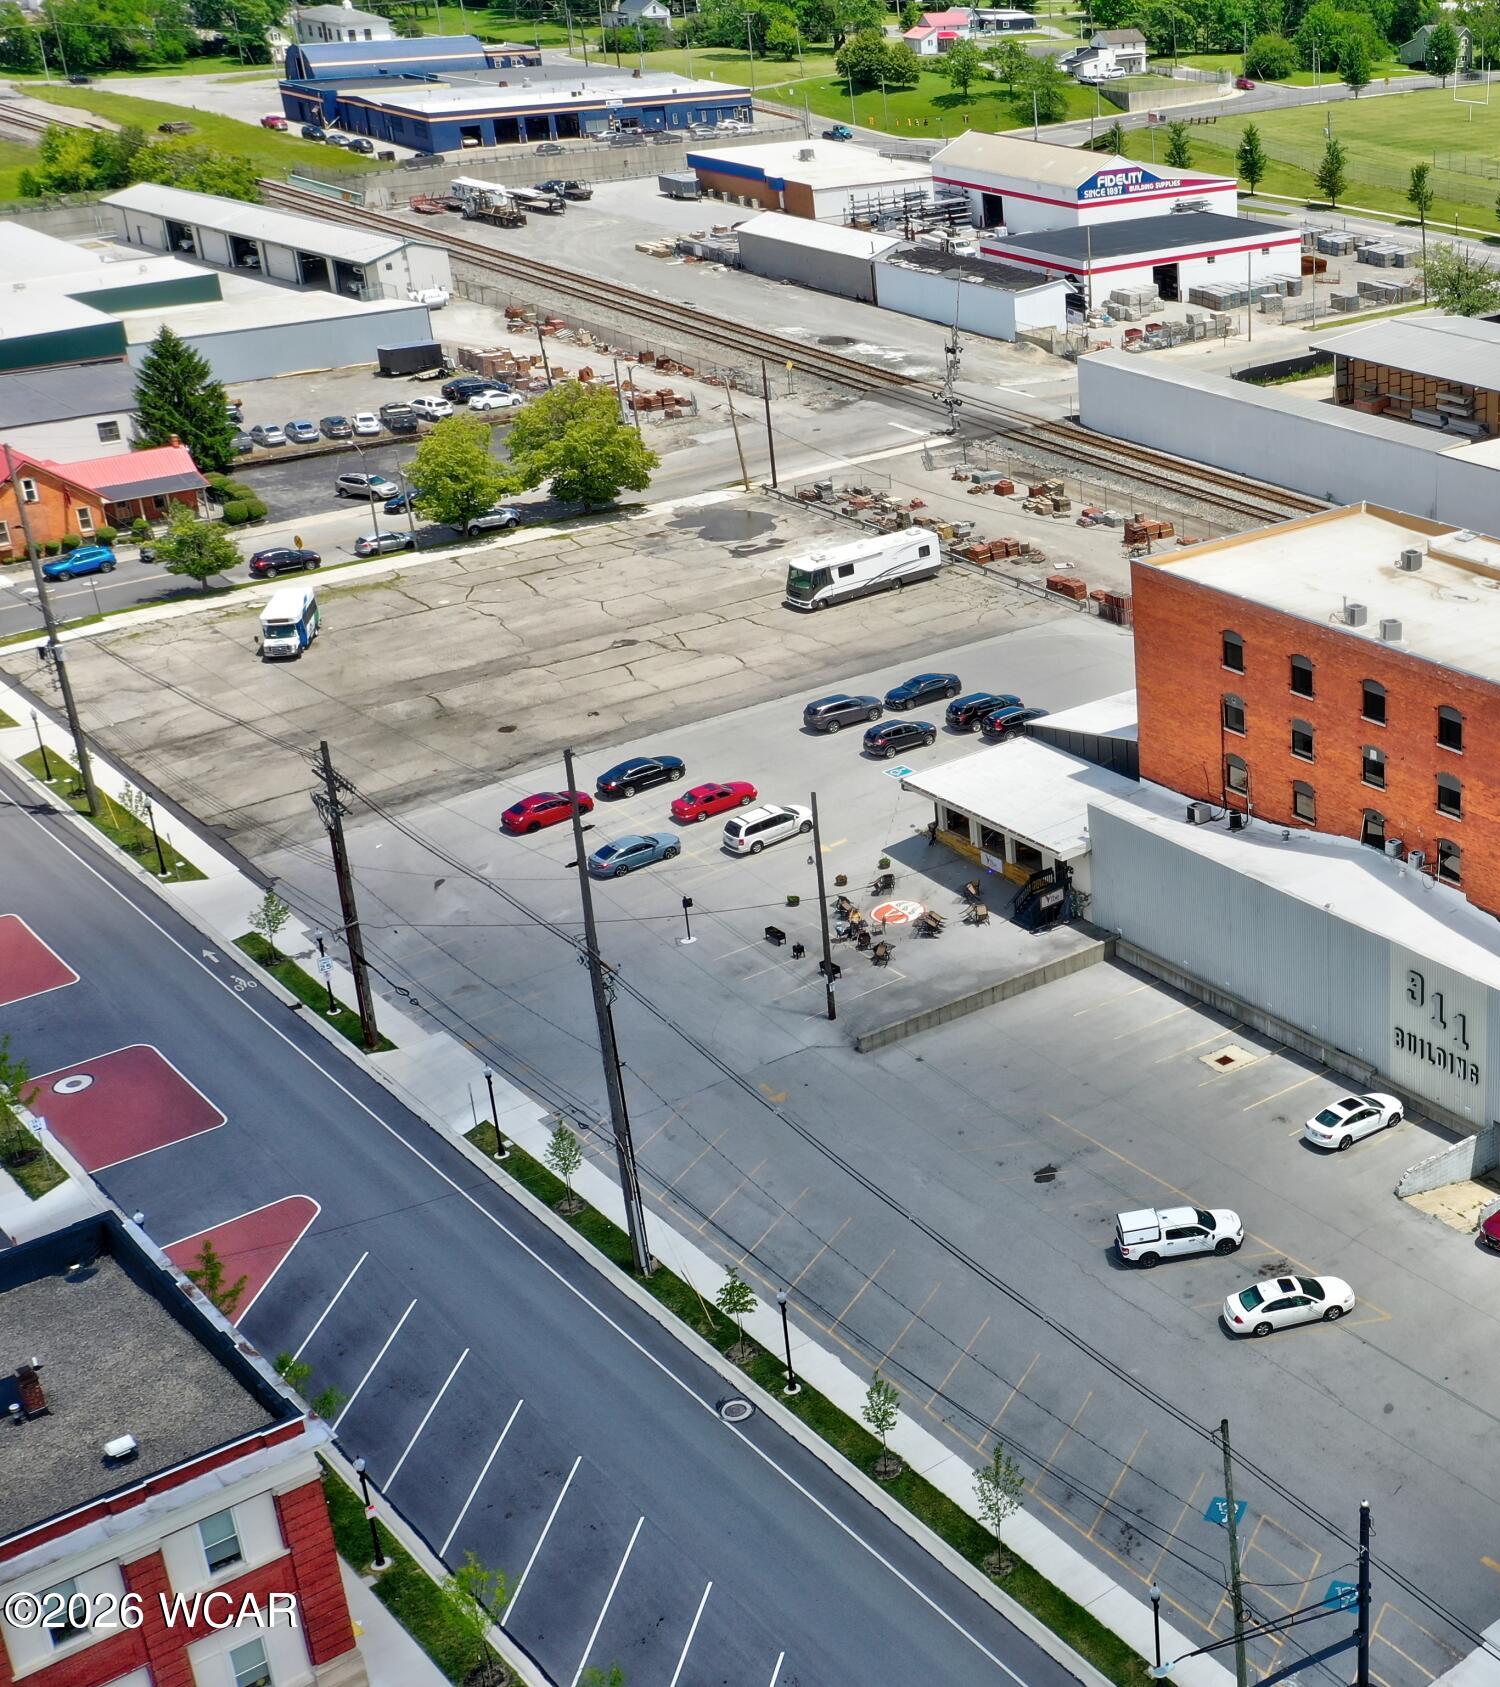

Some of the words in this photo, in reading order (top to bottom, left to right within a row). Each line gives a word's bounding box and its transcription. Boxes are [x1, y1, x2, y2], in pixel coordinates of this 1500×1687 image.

[1096, 170, 1143, 188] FIDELITY
[1128, 183, 1154, 192] BUILDING
[1155, 179, 1181, 189] SUPPLIES
[1084, 188, 1106, 199] SINCE
[1394, 1026, 1479, 1086] BUILDING
